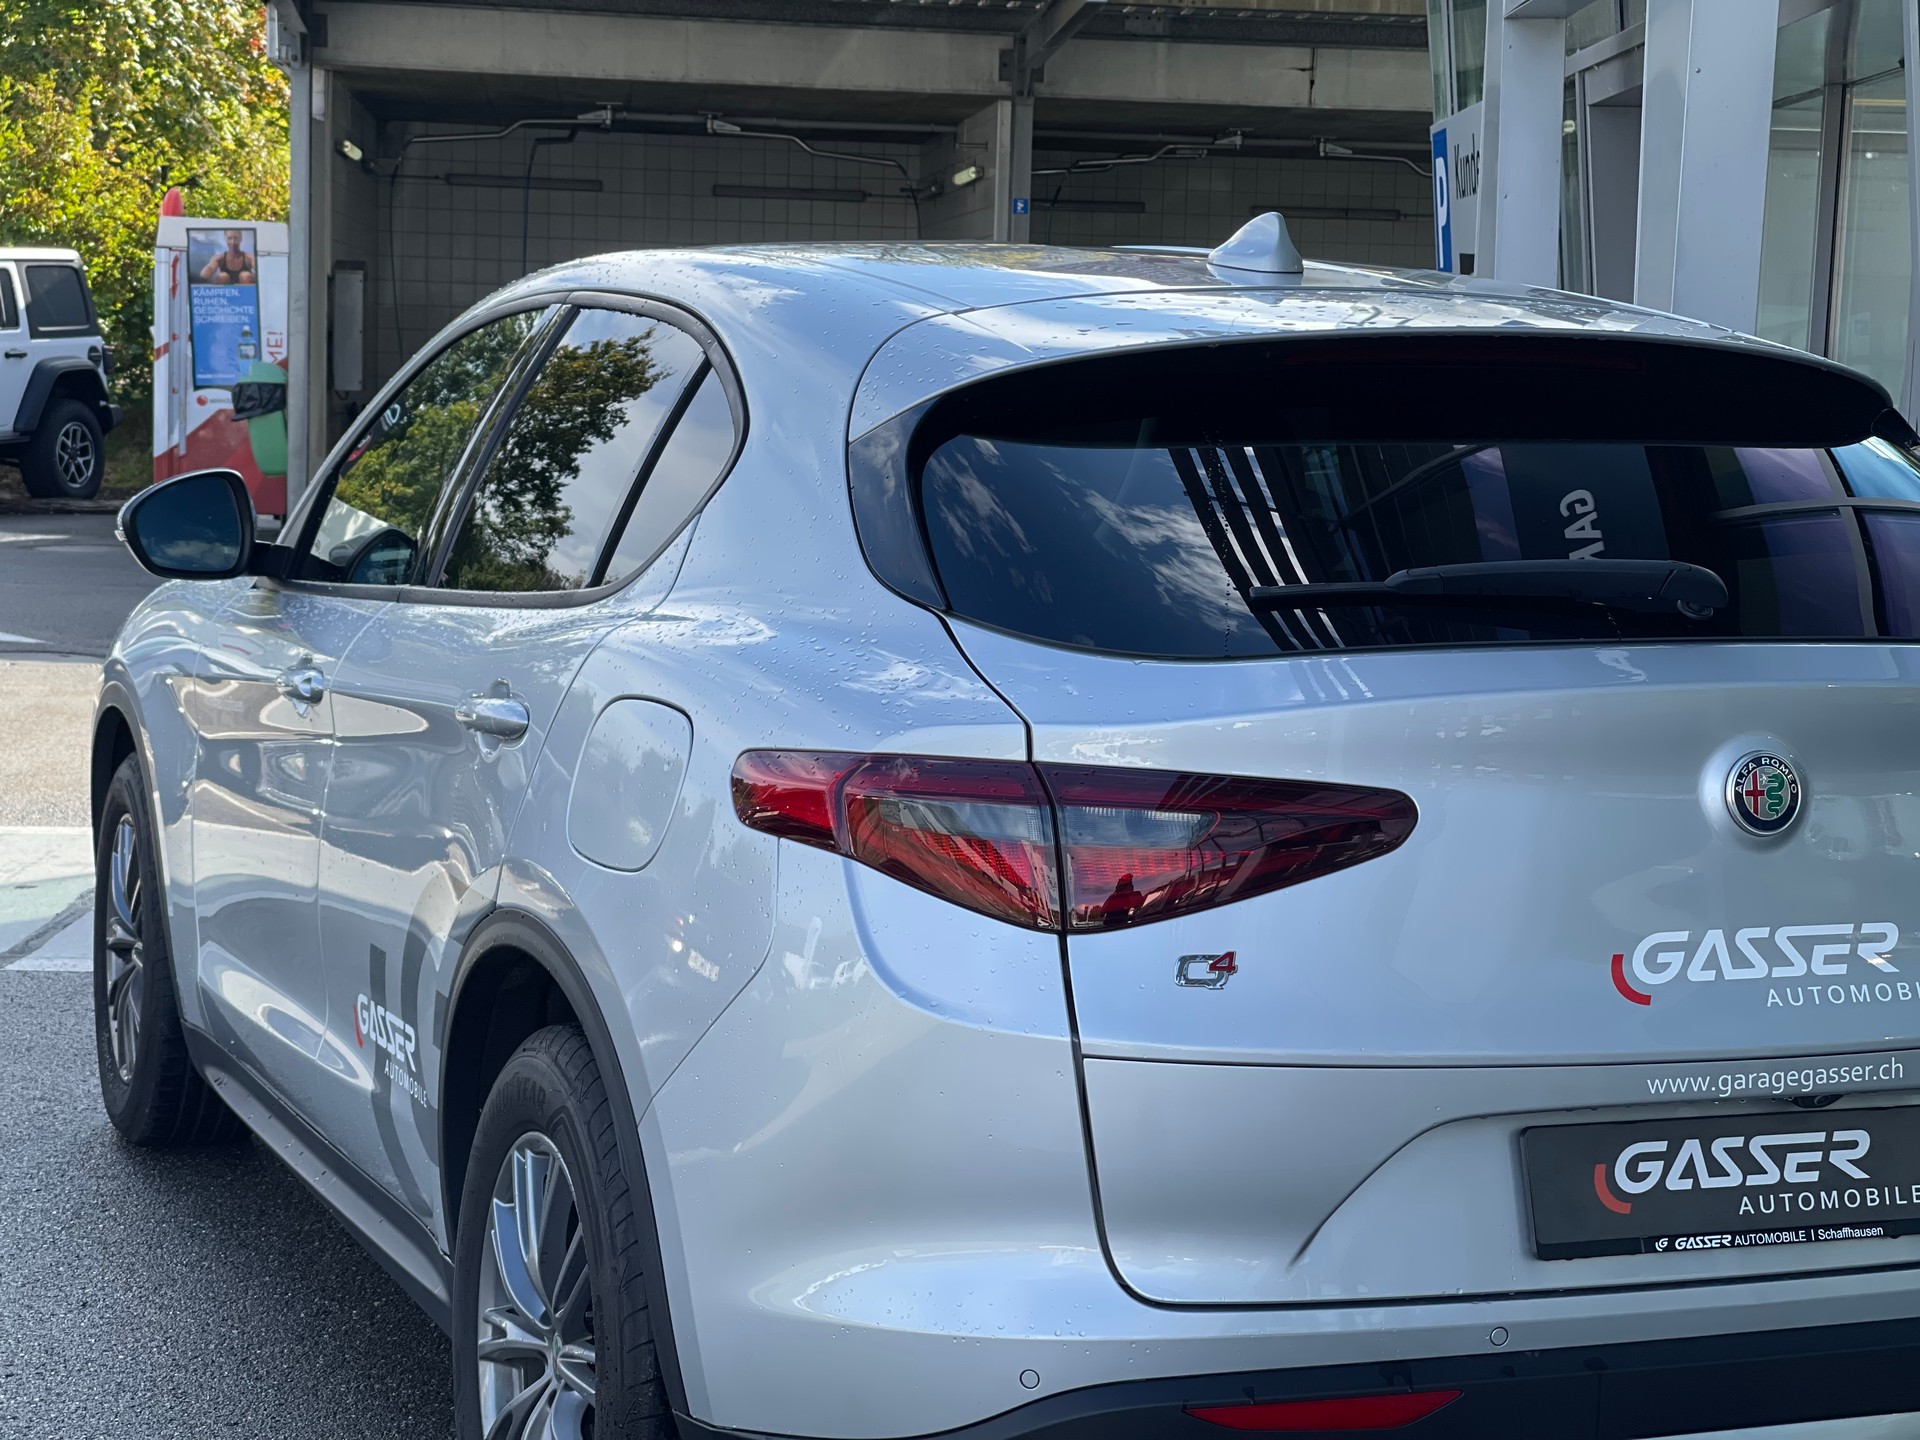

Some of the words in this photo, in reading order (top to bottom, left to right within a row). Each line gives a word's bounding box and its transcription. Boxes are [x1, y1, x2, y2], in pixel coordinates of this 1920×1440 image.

[1435, 157, 1448, 269] P
[1735, 761, 1757, 794] ALFA
[1761, 757, 1797, 794] ROMEO
[1632, 922, 1900, 985] GASSER
[357, 993, 417, 1073] GASSER
[384, 1059, 428, 1108] AUTOMOBILE
[1647, 1057, 1904, 1097] www.garagegasser.ch
[1614, 1129, 1872, 1194] GASSER
[1739, 1184, 1920, 1215] AUTOMOBILE
[1675, 1234, 1731, 1250] GASSER
[1734, 1230, 1807, 1246] AUTOMOBILE
[1818, 1226, 1884, 1241] Schaffhausen
